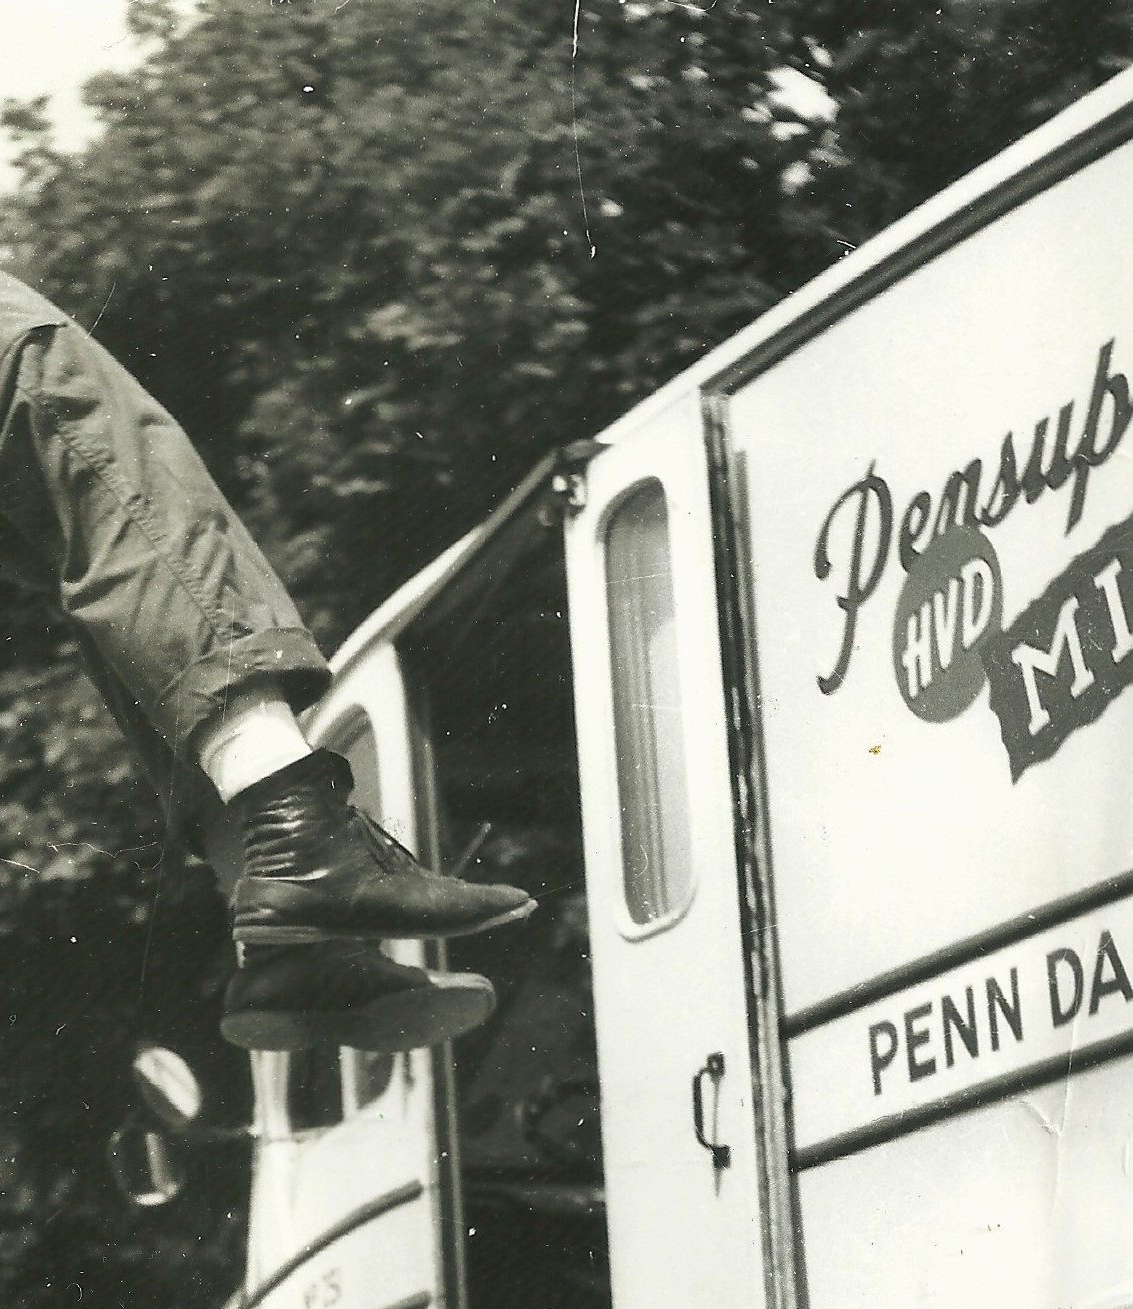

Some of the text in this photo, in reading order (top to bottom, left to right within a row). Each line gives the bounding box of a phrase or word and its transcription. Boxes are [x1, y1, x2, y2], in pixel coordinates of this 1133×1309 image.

[902, 556, 994, 699] HVD
[868, 929, 1133, 1097] PENN DA
